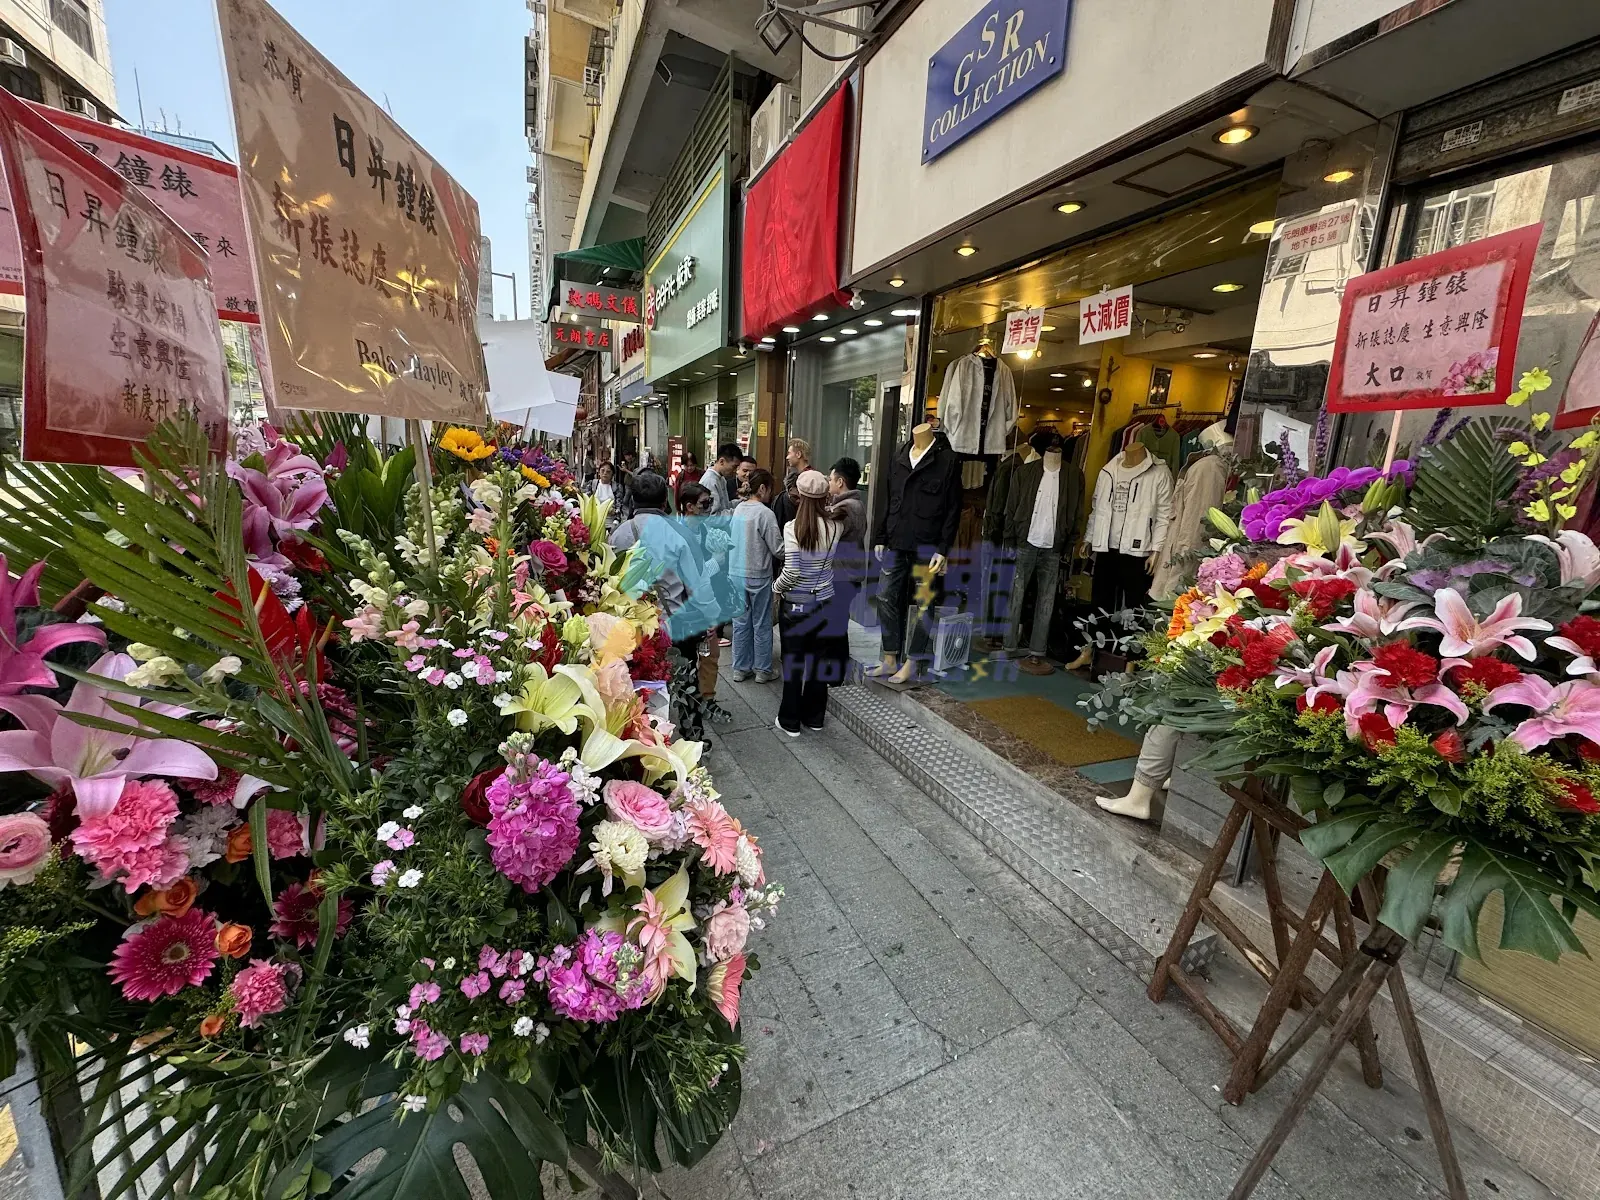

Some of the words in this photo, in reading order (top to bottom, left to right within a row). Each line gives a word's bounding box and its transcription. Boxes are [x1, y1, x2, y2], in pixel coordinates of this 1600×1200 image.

[262, 40, 303, 104] 恭賀
[952, 9, 1025, 98] GSR
[930, 32, 1052, 143] COLLECTION
[44, 167, 166, 275] 日昇鐘錶
[225, 296, 257, 316] 敬賀
[1367, 271, 1469, 314] 日昇鐘錶
[1008, 315, 1040, 347] 清貨
[1083, 293, 1131, 335] 大減價
[1354, 324, 1411, 350] 新張誌慶
[1421, 311, 1488, 341] 生意興隆
[108, 316, 191, 381] 生意興隆
[555, 327, 609, 347] 元朗書店
[1364, 361, 1405, 388] 大口
